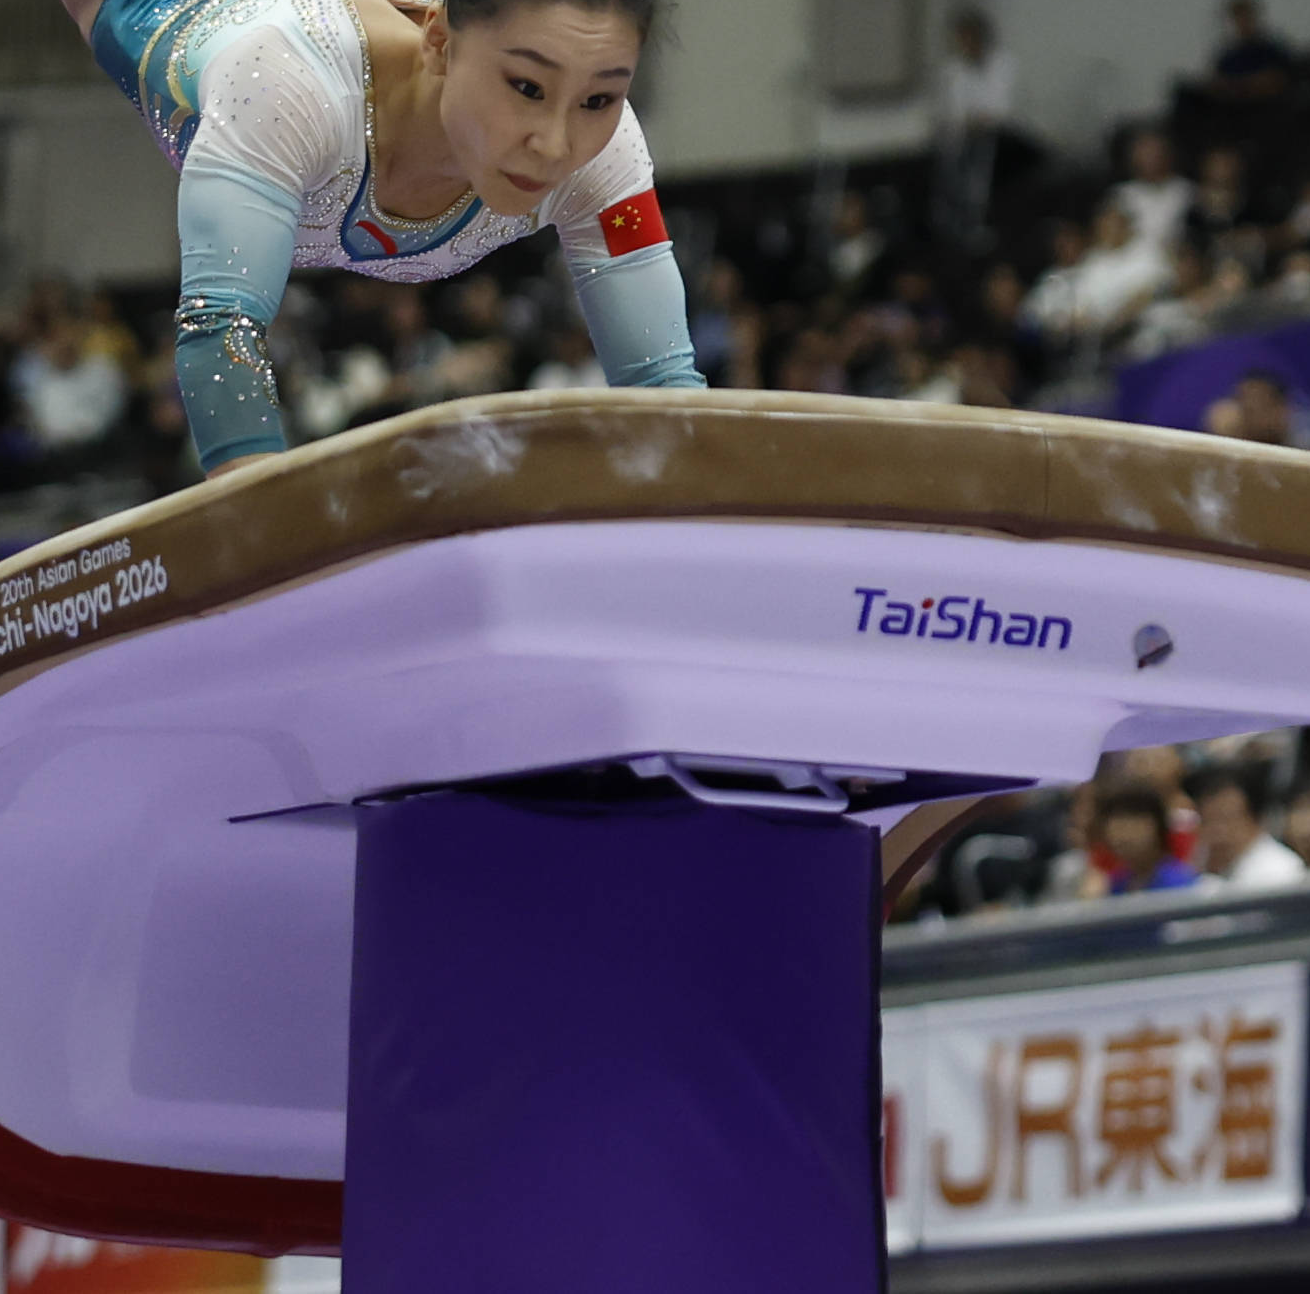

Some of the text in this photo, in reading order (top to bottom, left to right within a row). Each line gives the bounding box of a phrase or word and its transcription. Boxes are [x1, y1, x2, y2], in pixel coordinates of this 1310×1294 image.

[0, 537, 131, 607] 20th Asian Games
[115, 555, 168, 607] 2026
[854, 587, 1072, 650] TaiShan
